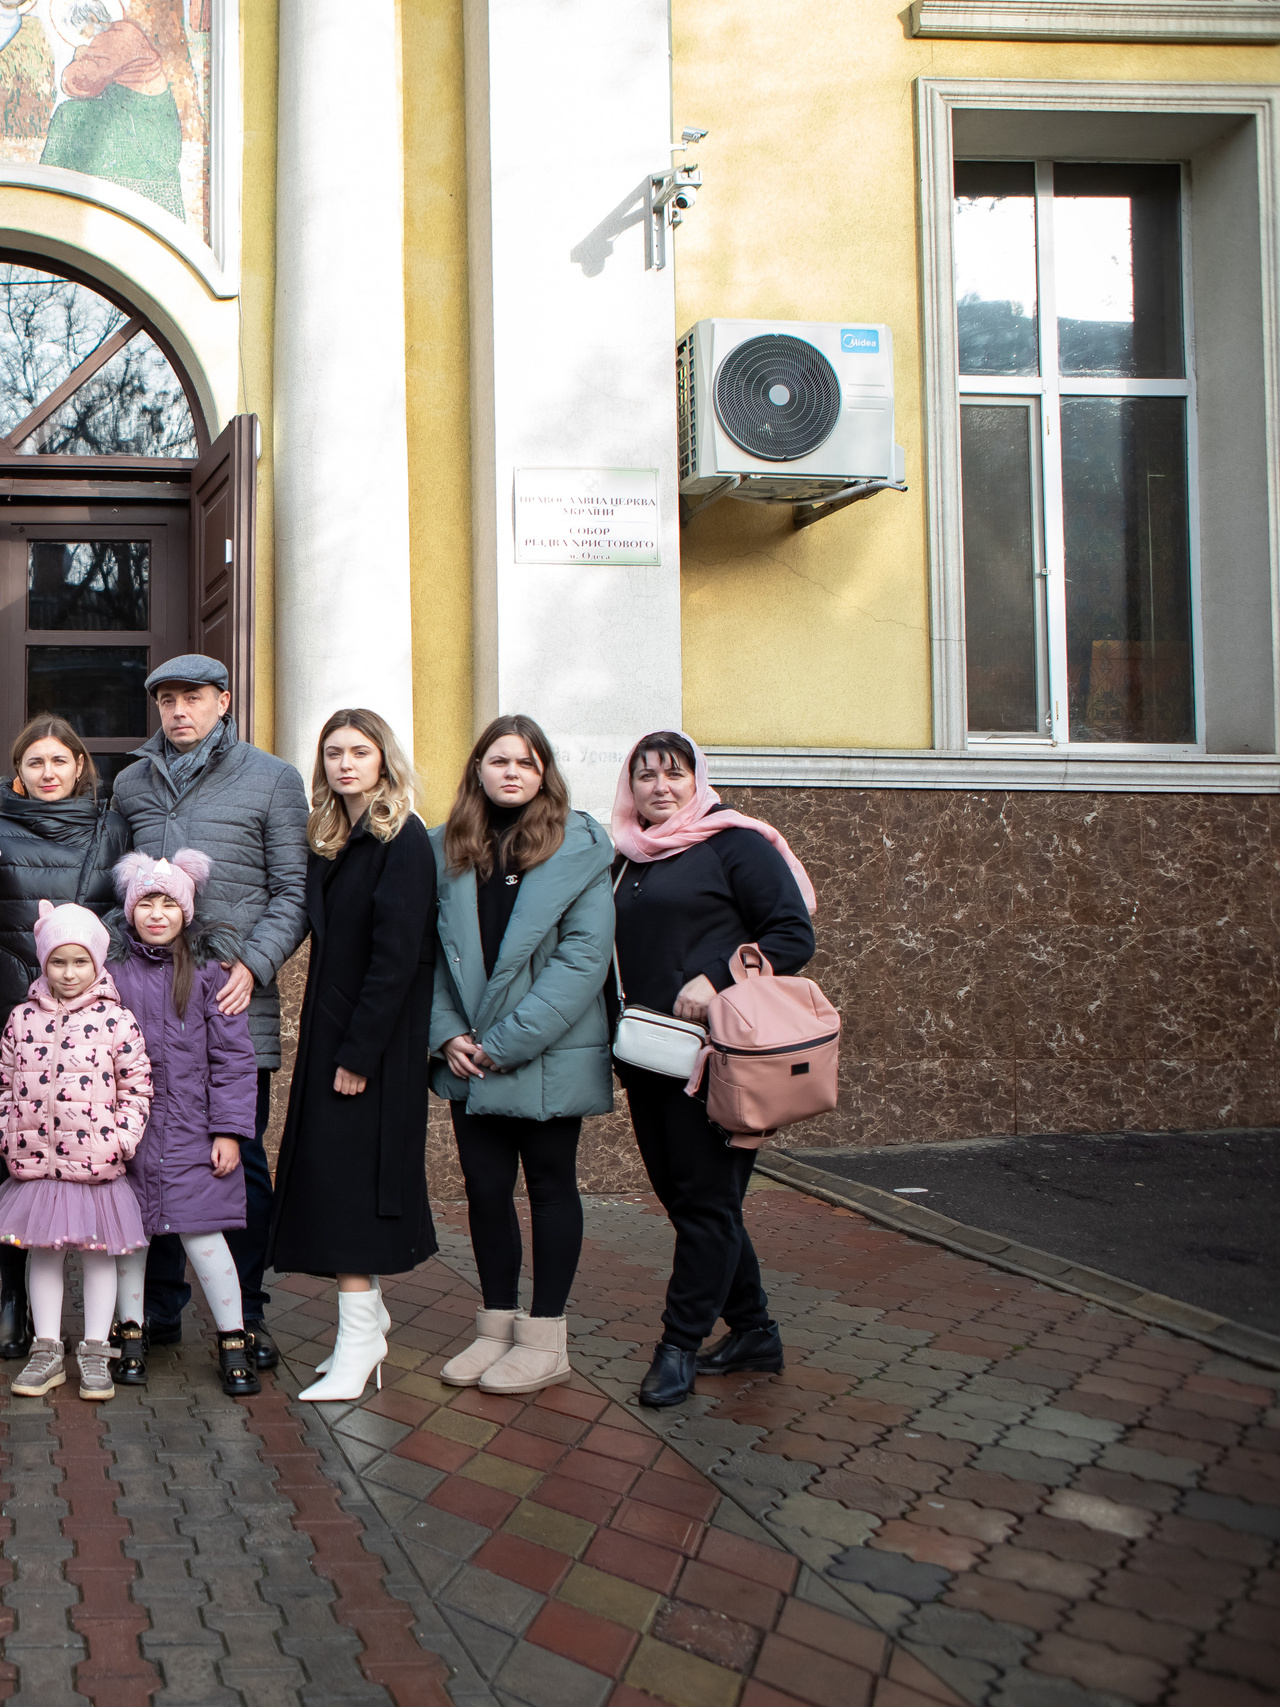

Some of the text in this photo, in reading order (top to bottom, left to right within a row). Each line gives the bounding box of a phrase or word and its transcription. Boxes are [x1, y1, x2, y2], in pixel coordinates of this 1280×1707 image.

[843, 335, 876, 347] Midea
[610, 497, 656, 507] ЦЕРКВА
[563, 506, 614, 516] УКРАЇНИ
[569, 527, 611, 536] СОБОР
[572, 539, 655, 549] ХРИСТОВОГО
[581, 551, 611, 561] Одеса
